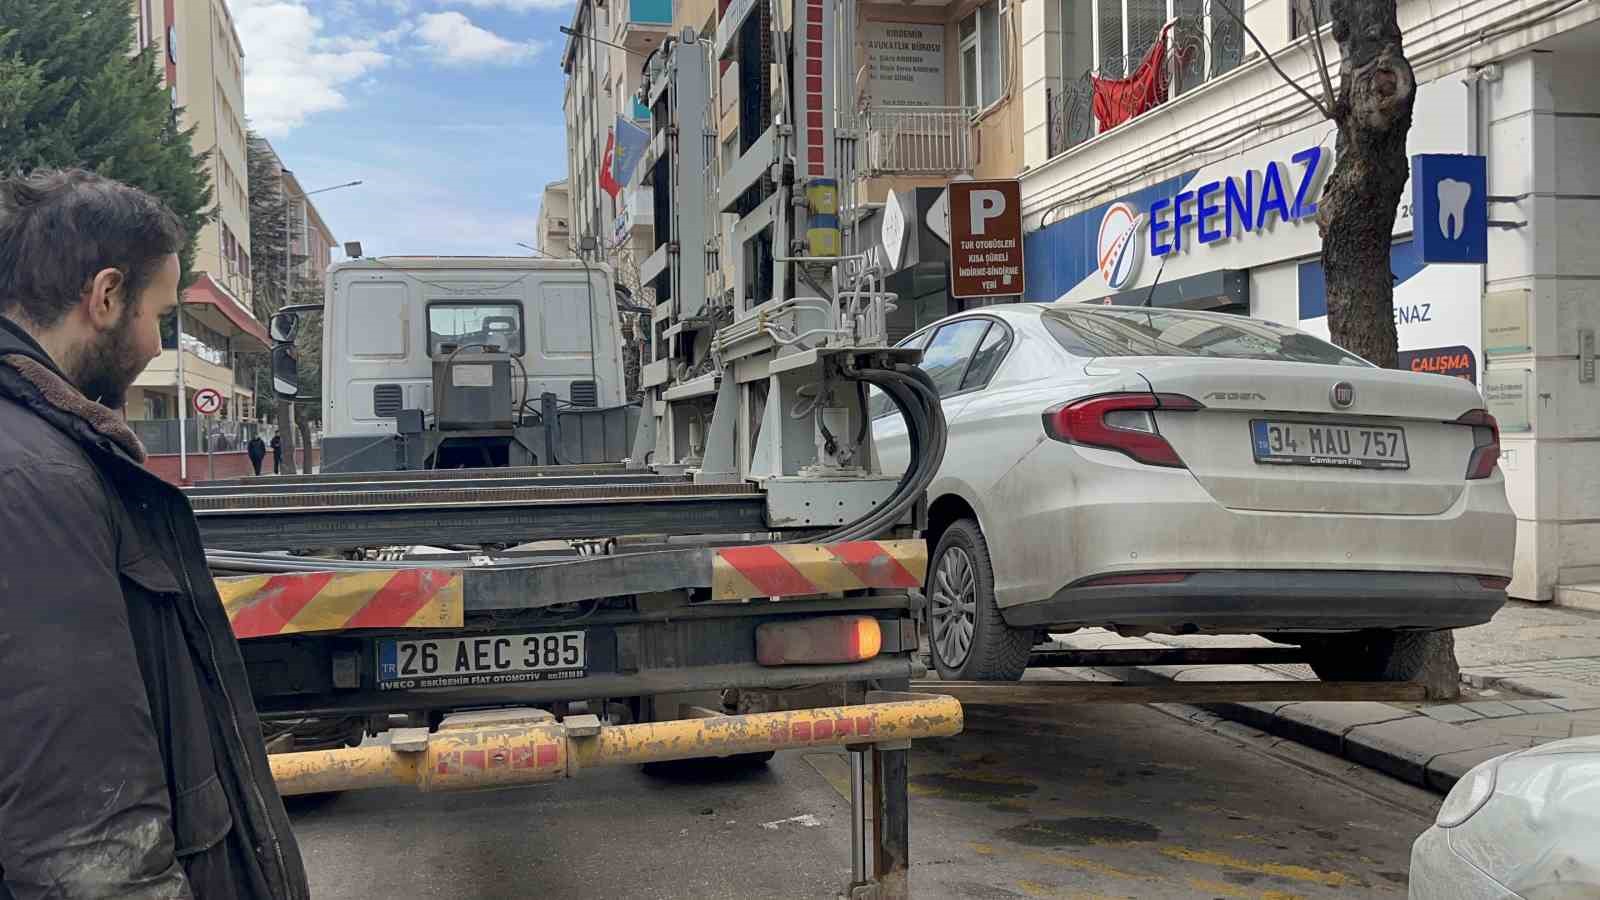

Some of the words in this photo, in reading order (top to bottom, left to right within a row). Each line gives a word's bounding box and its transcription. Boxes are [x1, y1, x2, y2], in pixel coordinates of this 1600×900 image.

[969, 190, 1006, 235] P
[1150, 146, 1321, 256] EFENAZ
[1269, 426, 1297, 452] 34
[1308, 428, 1351, 454] MAU
[1360, 431, 1398, 457] 757
[382, 663, 396, 673] TR
[400, 642, 439, 676] 26
[454, 638, 511, 672] AEC
[522, 634, 579, 668] 385
[381, 680, 415, 690] IVECO
